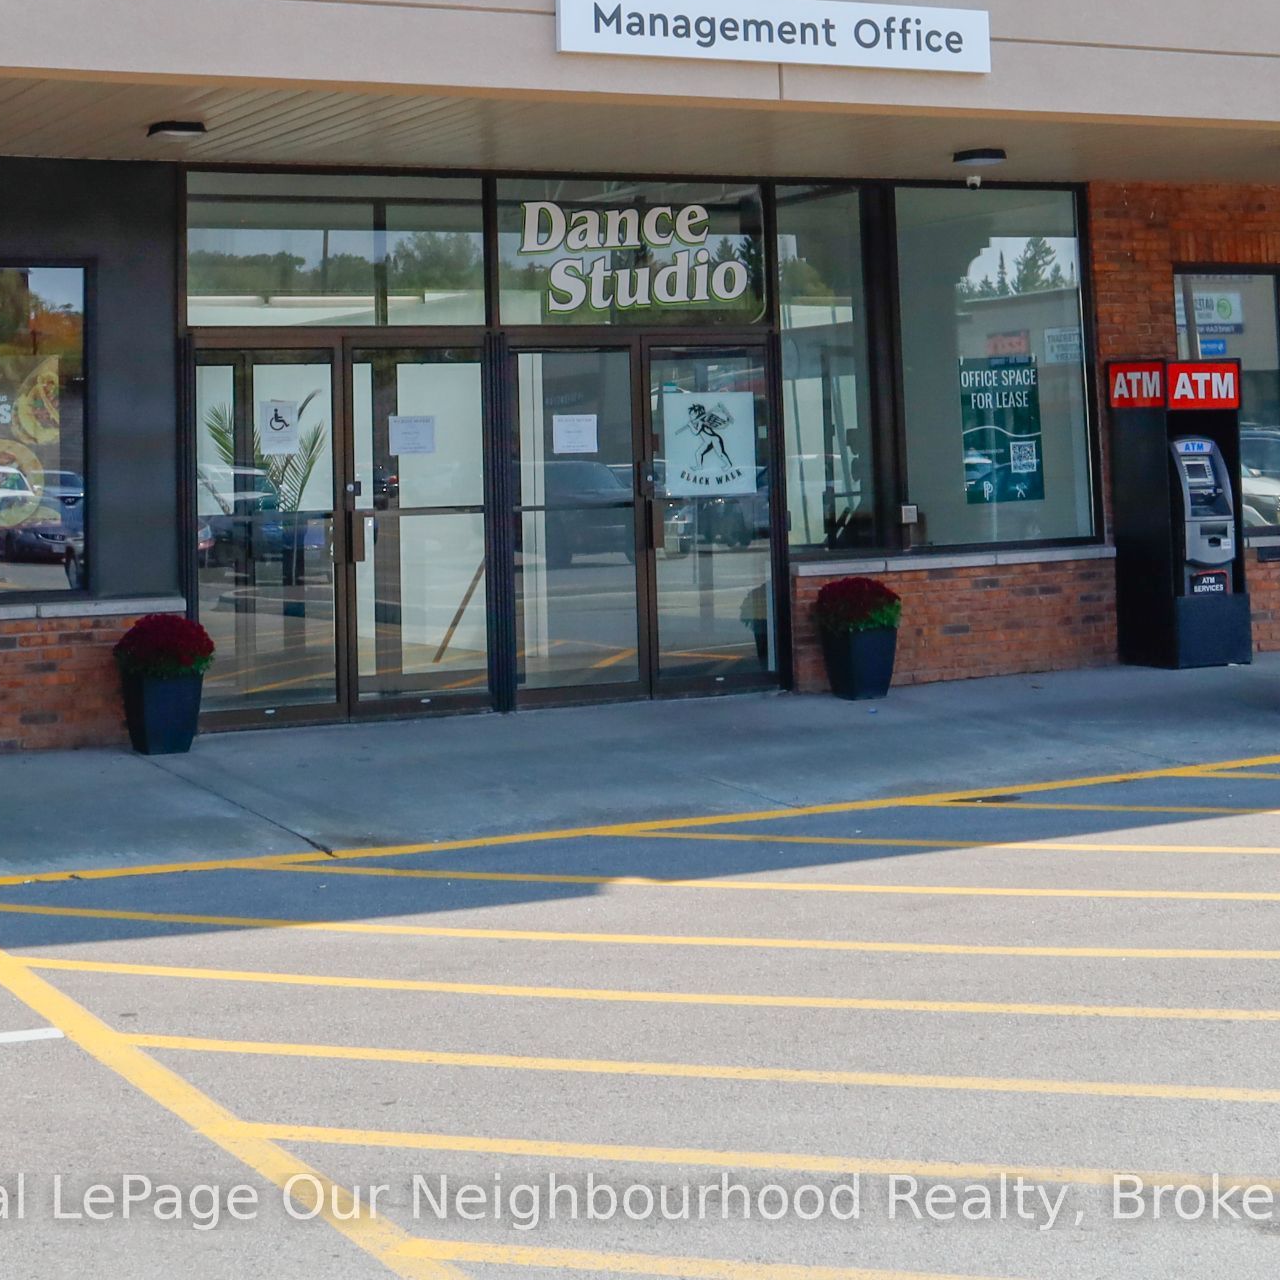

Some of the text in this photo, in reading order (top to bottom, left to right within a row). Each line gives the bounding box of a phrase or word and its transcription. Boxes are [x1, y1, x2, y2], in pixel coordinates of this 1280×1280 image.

[593, 2, 963, 54] Management Office
[518, 200, 710, 255] Dance
[548, 249, 748, 315] Studio
[960, 369, 1036, 388] OFFICE SPACE
[1113, 371, 1160, 399] ATM
[1173, 372, 1235, 400] ATM
[971, 391, 1029, 410] FOR LEASE
[1184, 442, 1205, 452] ATM
[681, 469, 742, 485] BLACK WALK
[1194, 584, 1224, 593] SERVICES
